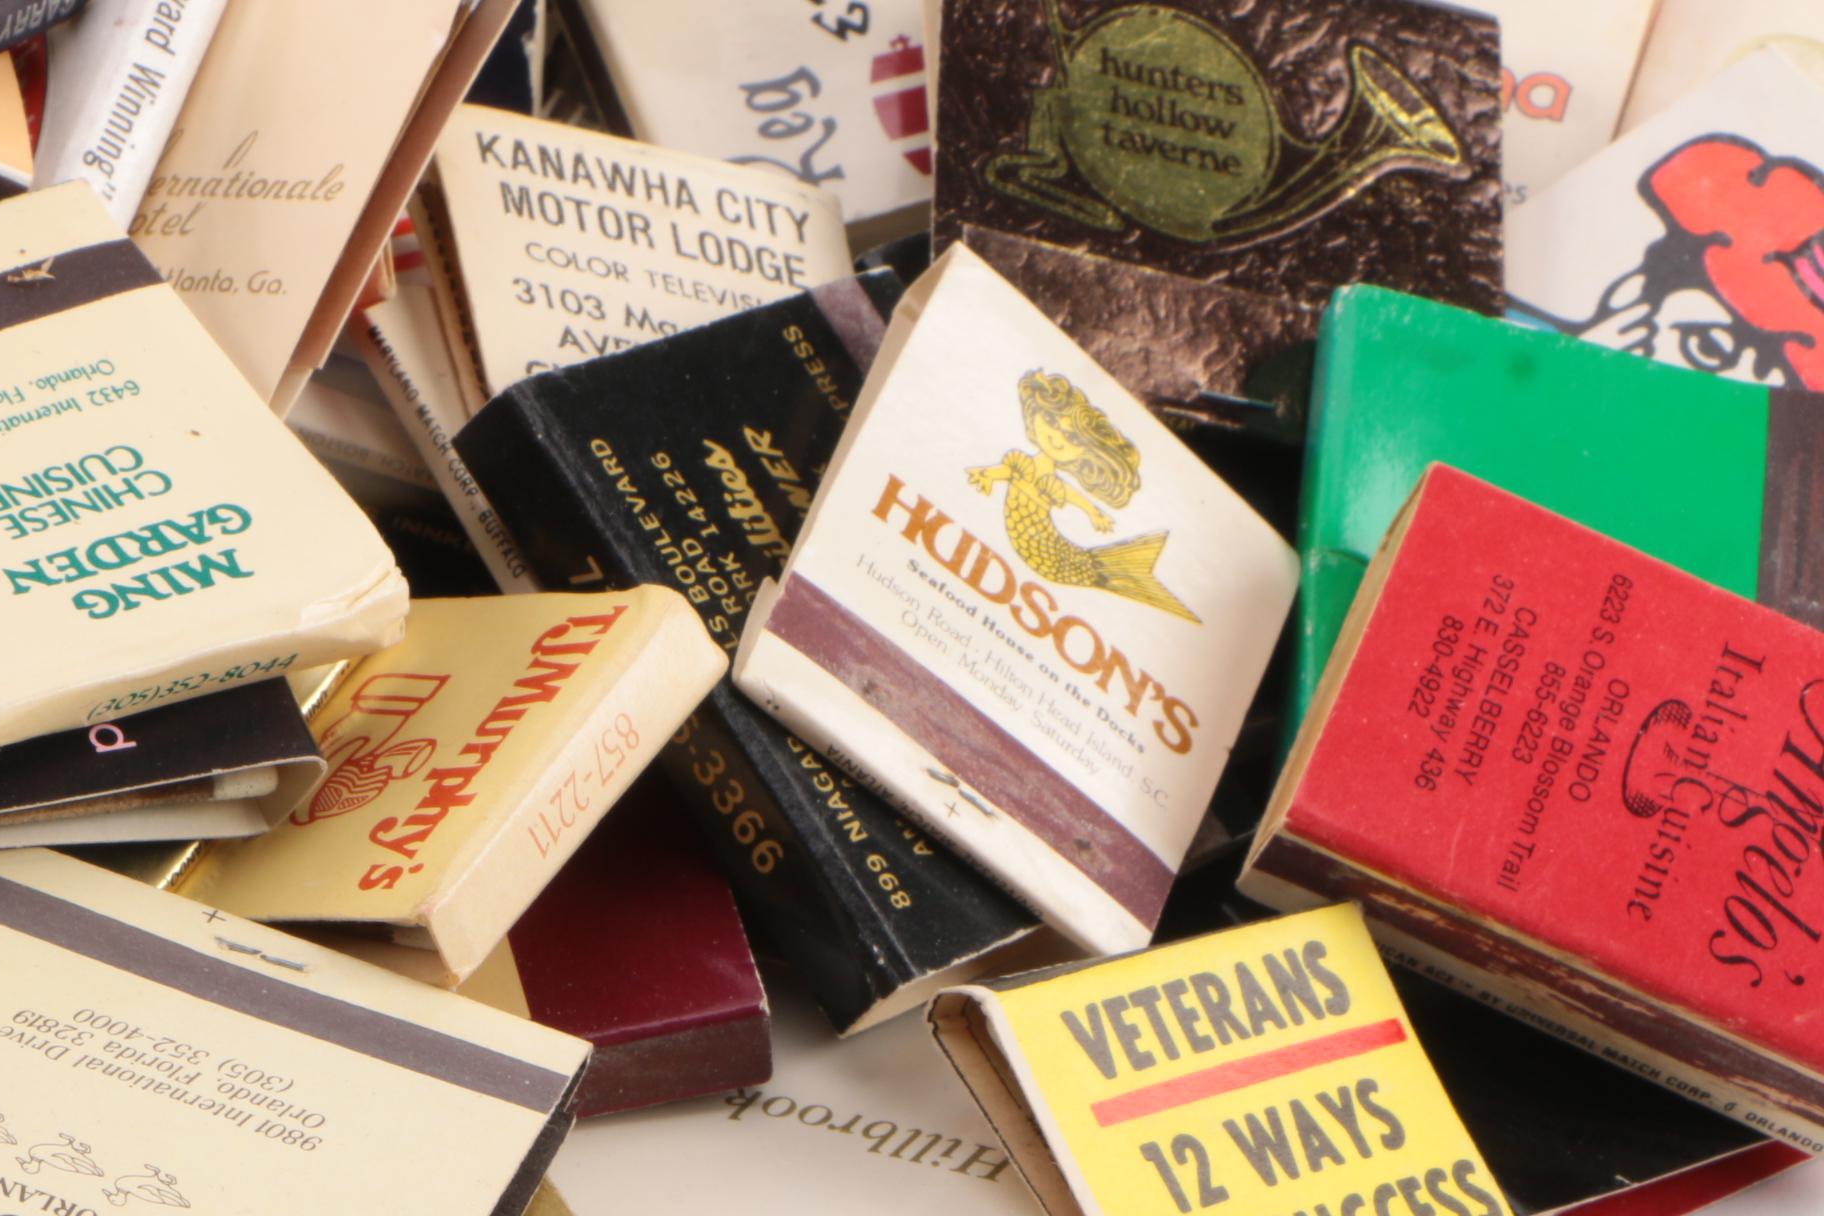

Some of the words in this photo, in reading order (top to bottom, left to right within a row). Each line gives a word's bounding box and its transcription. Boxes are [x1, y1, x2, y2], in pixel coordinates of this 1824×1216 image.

[142, 0, 182, 58] ard
[1098, 48, 1245, 107] hunters
[1110, 86, 1236, 142] hollow
[144, 170, 346, 204] ernationale
[475, 131, 701, 215] KANAWHA
[714, 184, 811, 244] CITY
[1100, 117, 1242, 179] taverne
[128, 201, 209, 237] otel
[498, 180, 655, 248] MOTOR
[676, 228, 808, 291] LODGE
[247, 269, 288, 297] Ga.
[511, 277, 608, 322] 3103
[525, 242, 630, 284] COLOR
[86, 378, 143, 408] 6432
[367, 324, 420, 403] MARYLAND
[415, 402, 453, 457] MATCH
[478, 508, 528, 580] BUFFALO
[650, 451, 721, 539] 14226
[2, 502, 253, 597] GARDEN
[589, 438, 711, 605] BOULEVARD
[71, 547, 254, 619] MING
[680, 537, 744, 616] ROAD
[871, 474, 1202, 757] HUDSON'S
[1482, 572, 1516, 614] 372
[1598, 572, 1635, 626] 6223
[856, 552, 922, 612] Hudson
[926, 607, 974, 648] Road
[983, 650, 1037, 698] Hilton
[1038, 688, 1082, 736] Head
[905, 558, 978, 618] Seafood
[981, 615, 1035, 662] House
[1038, 661, 1061, 684] on
[1063, 681, 1092, 708] the
[1095, 706, 1146, 755] Docks
[1406, 613, 1465, 721] 830-4922
[957, 652, 1024, 714] Monday
[1029, 710, 1102, 776] Saturday
[1431, 645, 1487, 743] Highway
[1454, 605, 1538, 788] CASSELBERRY
[1511, 660, 1567, 766] 855-6223
[1684, 640, 1767, 775] Italian
[1413, 748, 1446, 794] 436
[1568, 678, 1631, 803] ORLANDO
[528, 711, 642, 861] 857-2211
[1519, 740, 1575, 845] Blossom
[865, 851, 914, 911] 899
[1496, 840, 1536, 894] Trail
[1626, 772, 1715, 922] Cuisine
[11, 1006, 87, 1046] 32819
[73, 1005, 211, 1067] 352-4000
[1060, 940, 1351, 1081] VETERANS
[73, 1048, 265, 1134] International
[101, 1038, 204, 1089] Florida
[216, 1054, 297, 1098] (305)
[216, 1077, 328, 1127] Orlando,
[1601, 1037, 1661, 1079] MATCH
[1665, 1075, 1715, 1104] CORP.
[1744, 1110, 1824, 1154] ORLANDO
[269, 1118, 324, 1152] 9801
[722, 1085, 1011, 1185] Hillbrook
[1140, 1130, 1230, 1215] 12
[1222, 1077, 1407, 1189] WAYS
